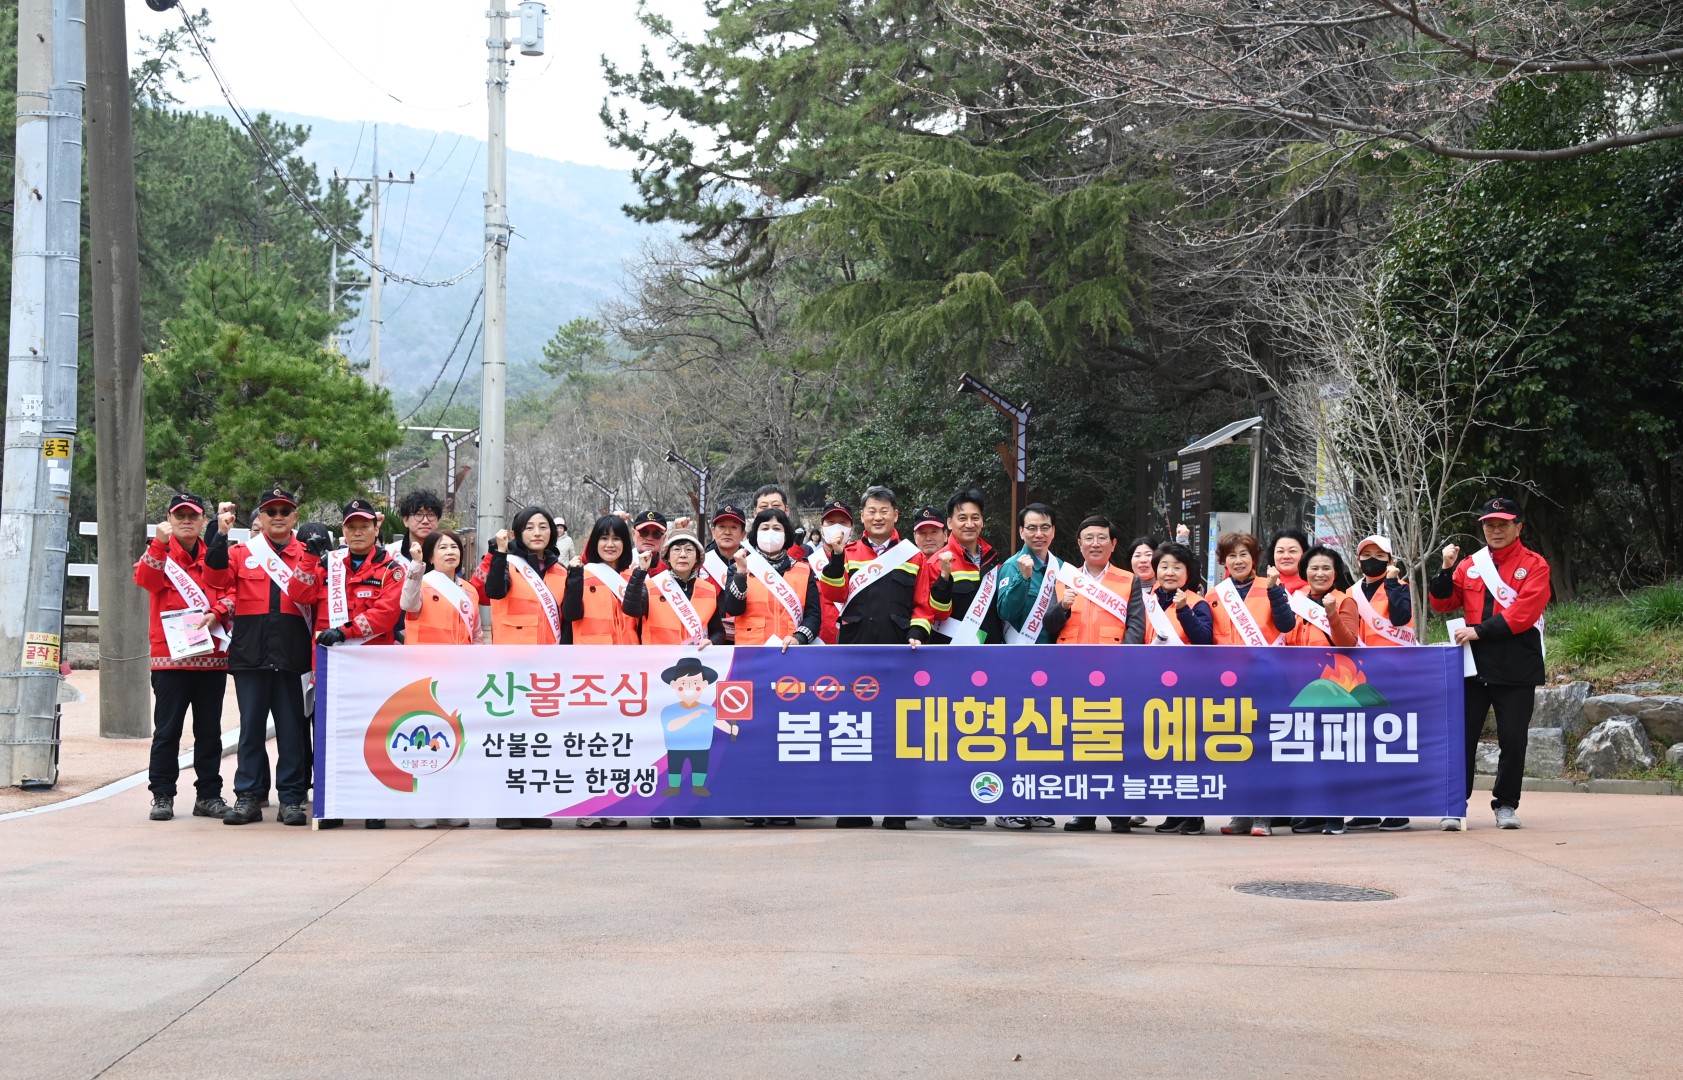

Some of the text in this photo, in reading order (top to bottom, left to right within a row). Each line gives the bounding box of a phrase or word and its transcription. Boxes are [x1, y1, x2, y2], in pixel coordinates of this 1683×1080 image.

[332, 562, 343, 613] 산불조심
[972, 571, 995, 617] 산불조심
[1028, 583, 1053, 633] 산불조심
[26, 645, 50, 660] 굴착
[476, 671, 648, 717] 산불조심
[482, 731, 633, 758] 산불은 한순간
[777, 696, 1419, 763] 봄철 대형산불 예방 캠페인
[400, 759, 438, 769] 산불조심
[505, 767, 656, 795] 복구는 한평생
[1011, 774, 1227, 800] 해운대구 늘푸른과
